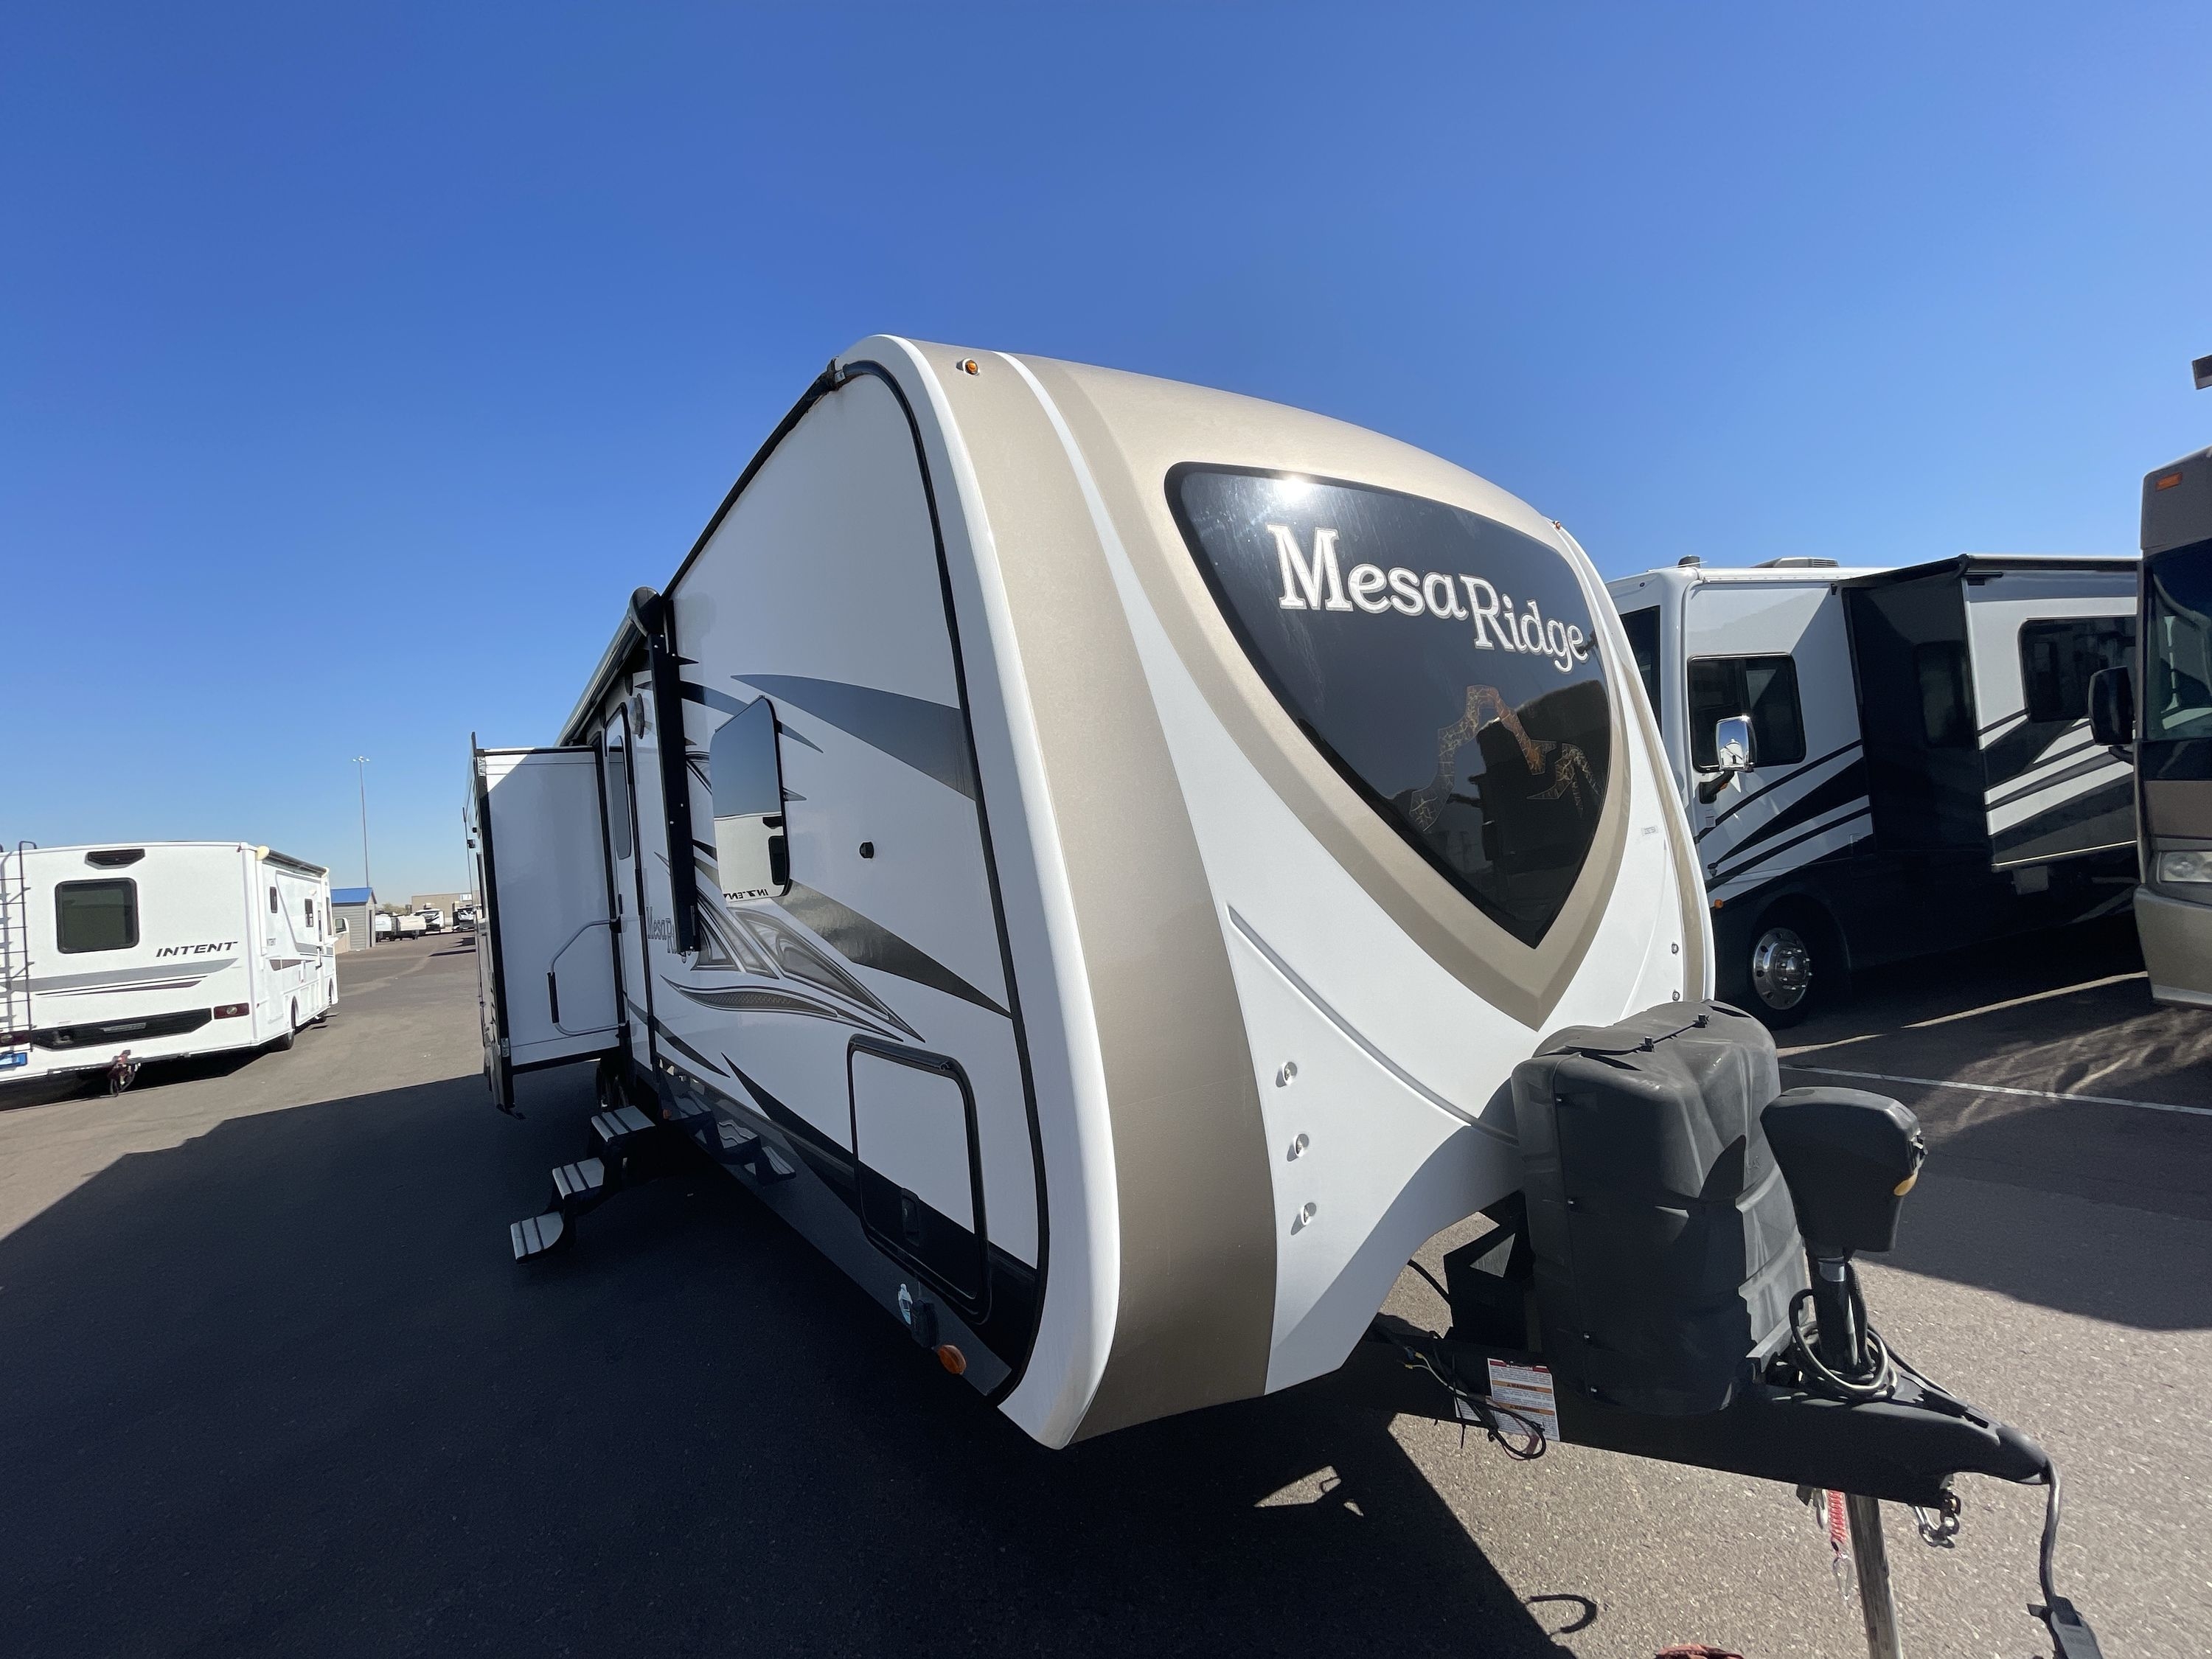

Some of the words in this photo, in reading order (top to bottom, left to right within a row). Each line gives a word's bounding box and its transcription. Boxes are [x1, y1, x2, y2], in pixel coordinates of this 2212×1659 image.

[1267, 524, 1469, 621] Mesa
[1458, 574, 1588, 674] Ridge
[646, 906, 667, 940] Mesa
[156, 942, 238, 957] INTENT
